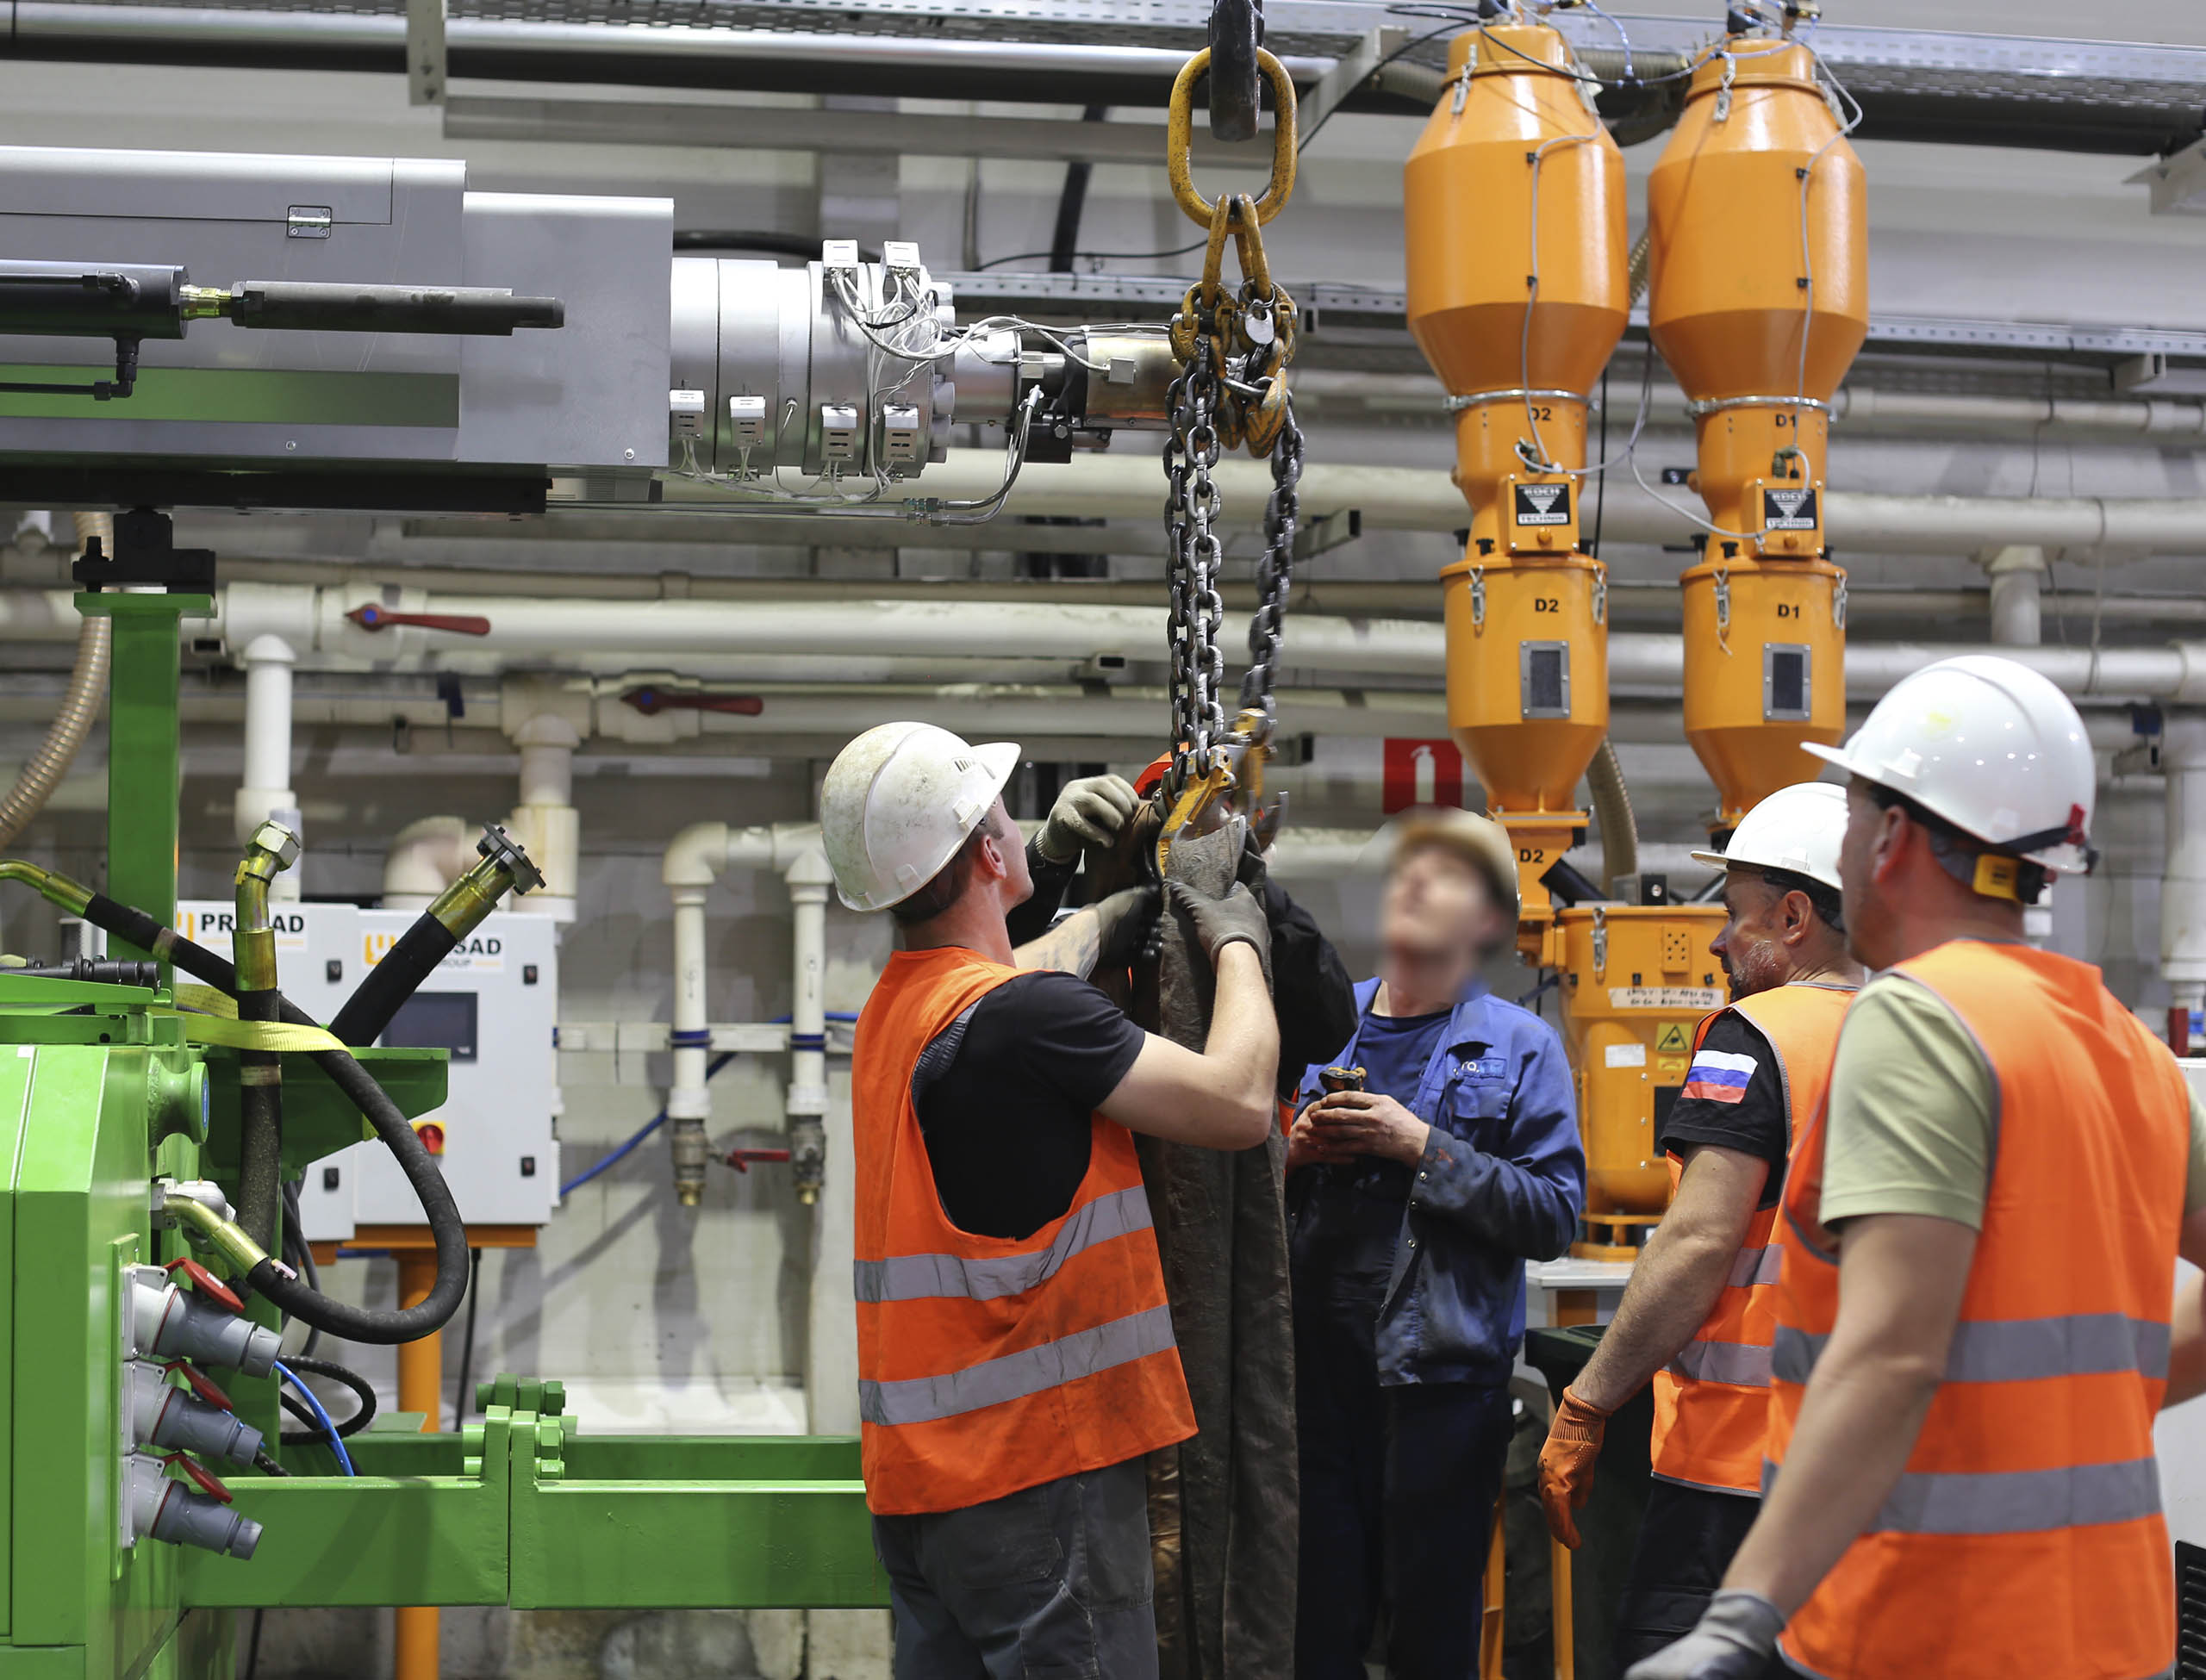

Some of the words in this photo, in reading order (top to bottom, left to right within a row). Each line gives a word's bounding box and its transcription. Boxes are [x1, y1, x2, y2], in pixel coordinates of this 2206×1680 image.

[1528, 408, 1551, 421] D2
[1775, 414, 1798, 428] D1
[1535, 598, 1559, 613] D2
[1778, 604, 1799, 619] D1
[1519, 849, 1544, 863] D2
[201, 913, 304, 933] PRAD
